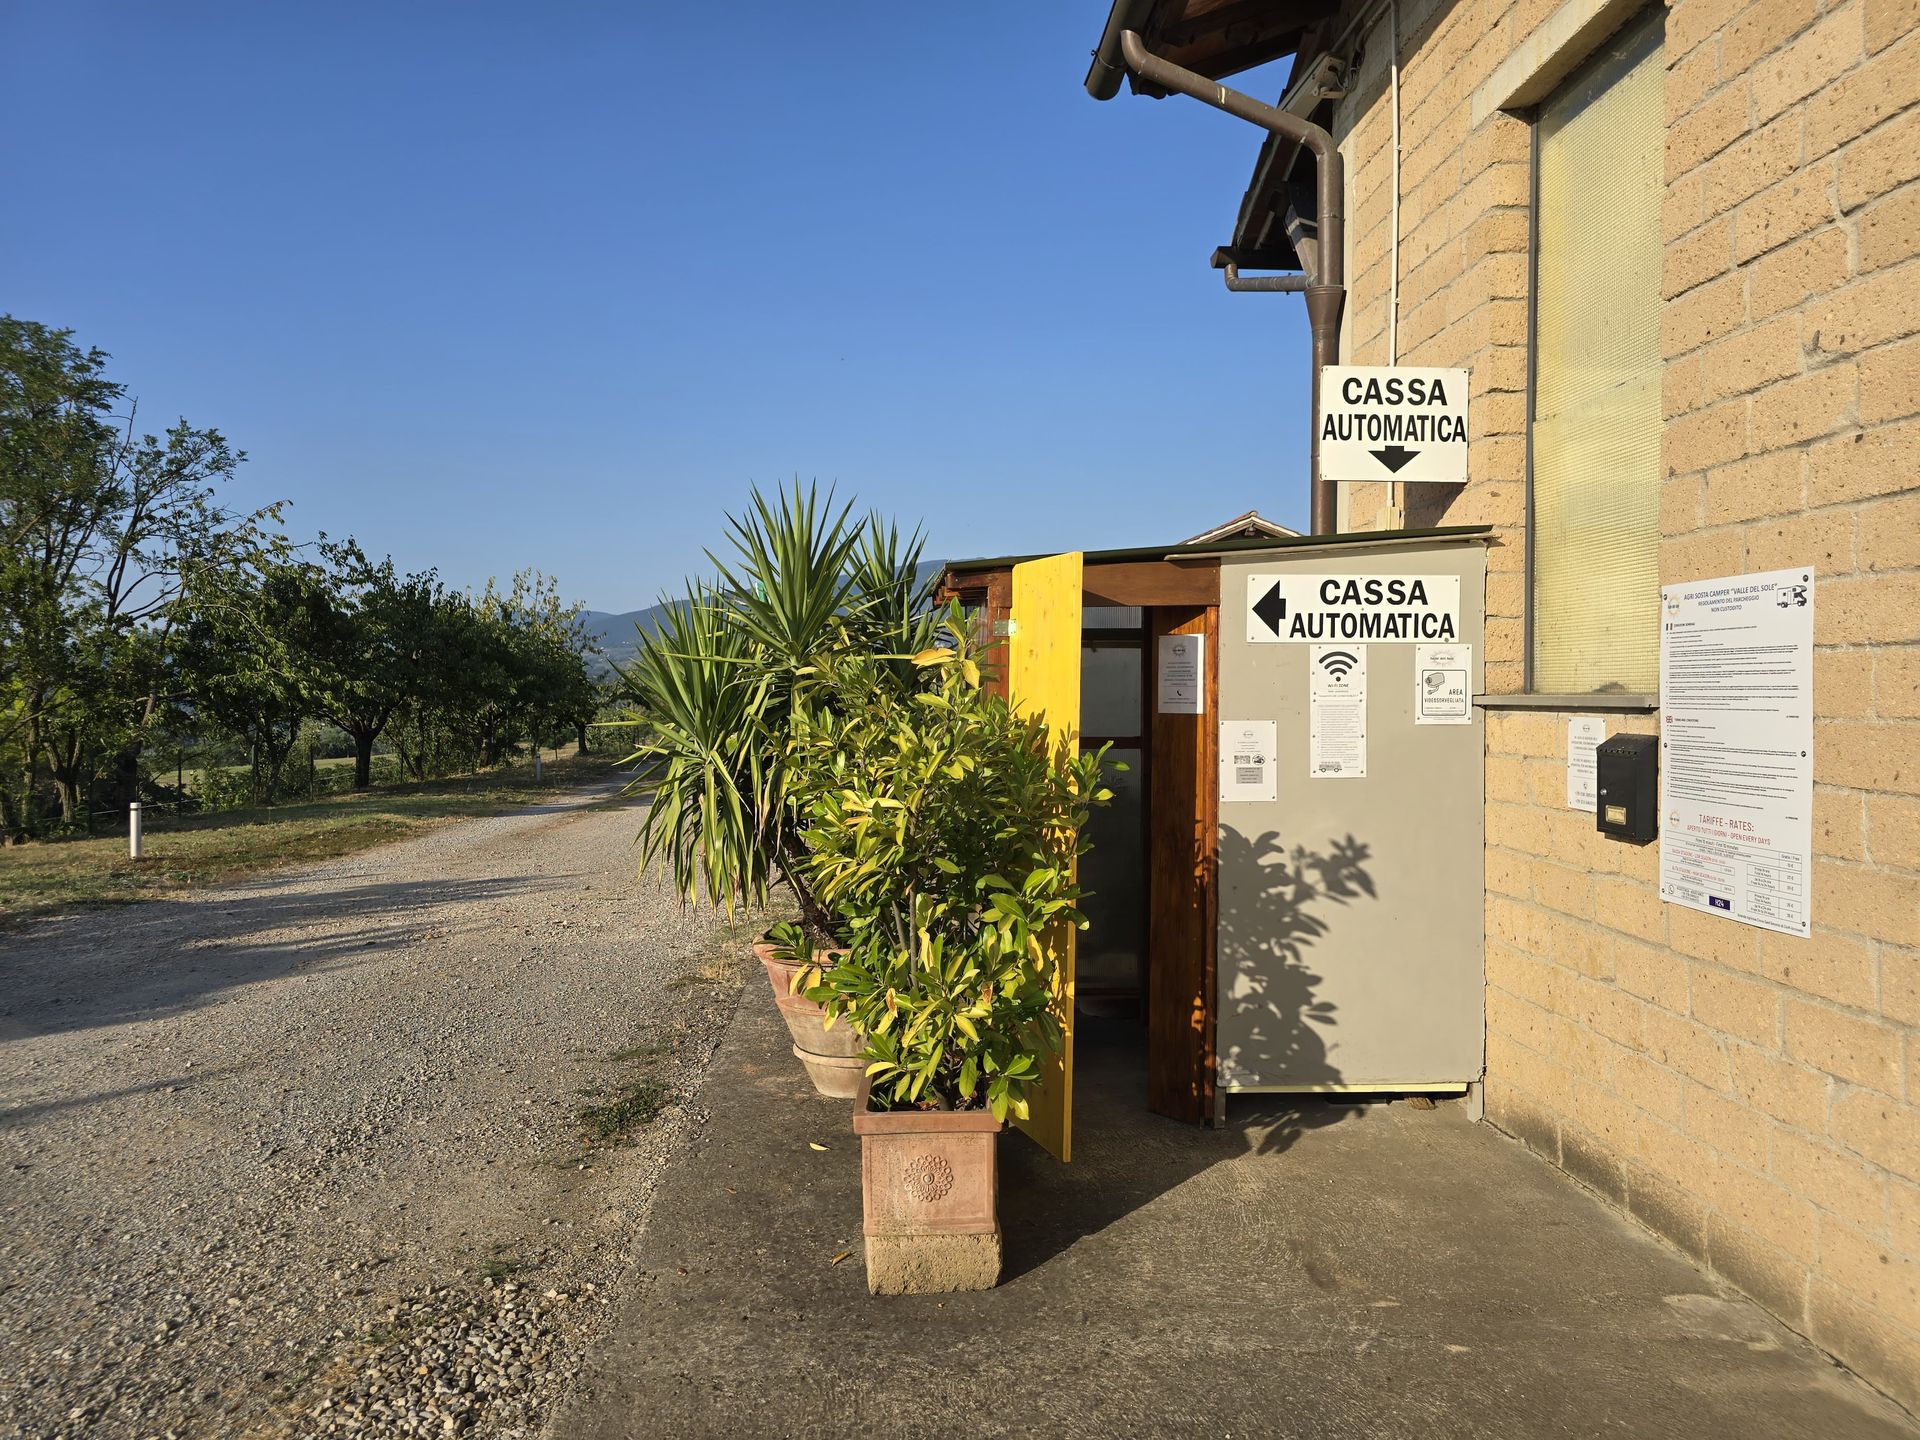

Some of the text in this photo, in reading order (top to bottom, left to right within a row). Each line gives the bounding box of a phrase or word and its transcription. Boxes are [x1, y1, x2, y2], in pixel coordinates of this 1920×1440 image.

[1342, 377, 1448, 406] CASSA
[1322, 413, 1467, 442] AUTOMATICA
[1319, 579, 1428, 606] CASSA
[1695, 590, 1709, 600] SOSTA
[1709, 588, 1730, 598] CAMPER
[1749, 585, 1760, 593] DEL
[1720, 604, 1743, 612] CUSTODITO
[1289, 612, 1455, 639] AUTOMATICA
[1448, 688, 1463, 696] AREA
[1699, 814, 1724, 827] TARIFFE
[1729, 819, 1755, 832] RATES:
[1687, 824, 1701, 833] APERTO
[1714, 829, 1727, 838] GIORNI
[1730, 832, 1742, 841] OPEN
[1742, 834, 1758, 844] EVERY
[1757, 836, 1771, 846] DAYS
